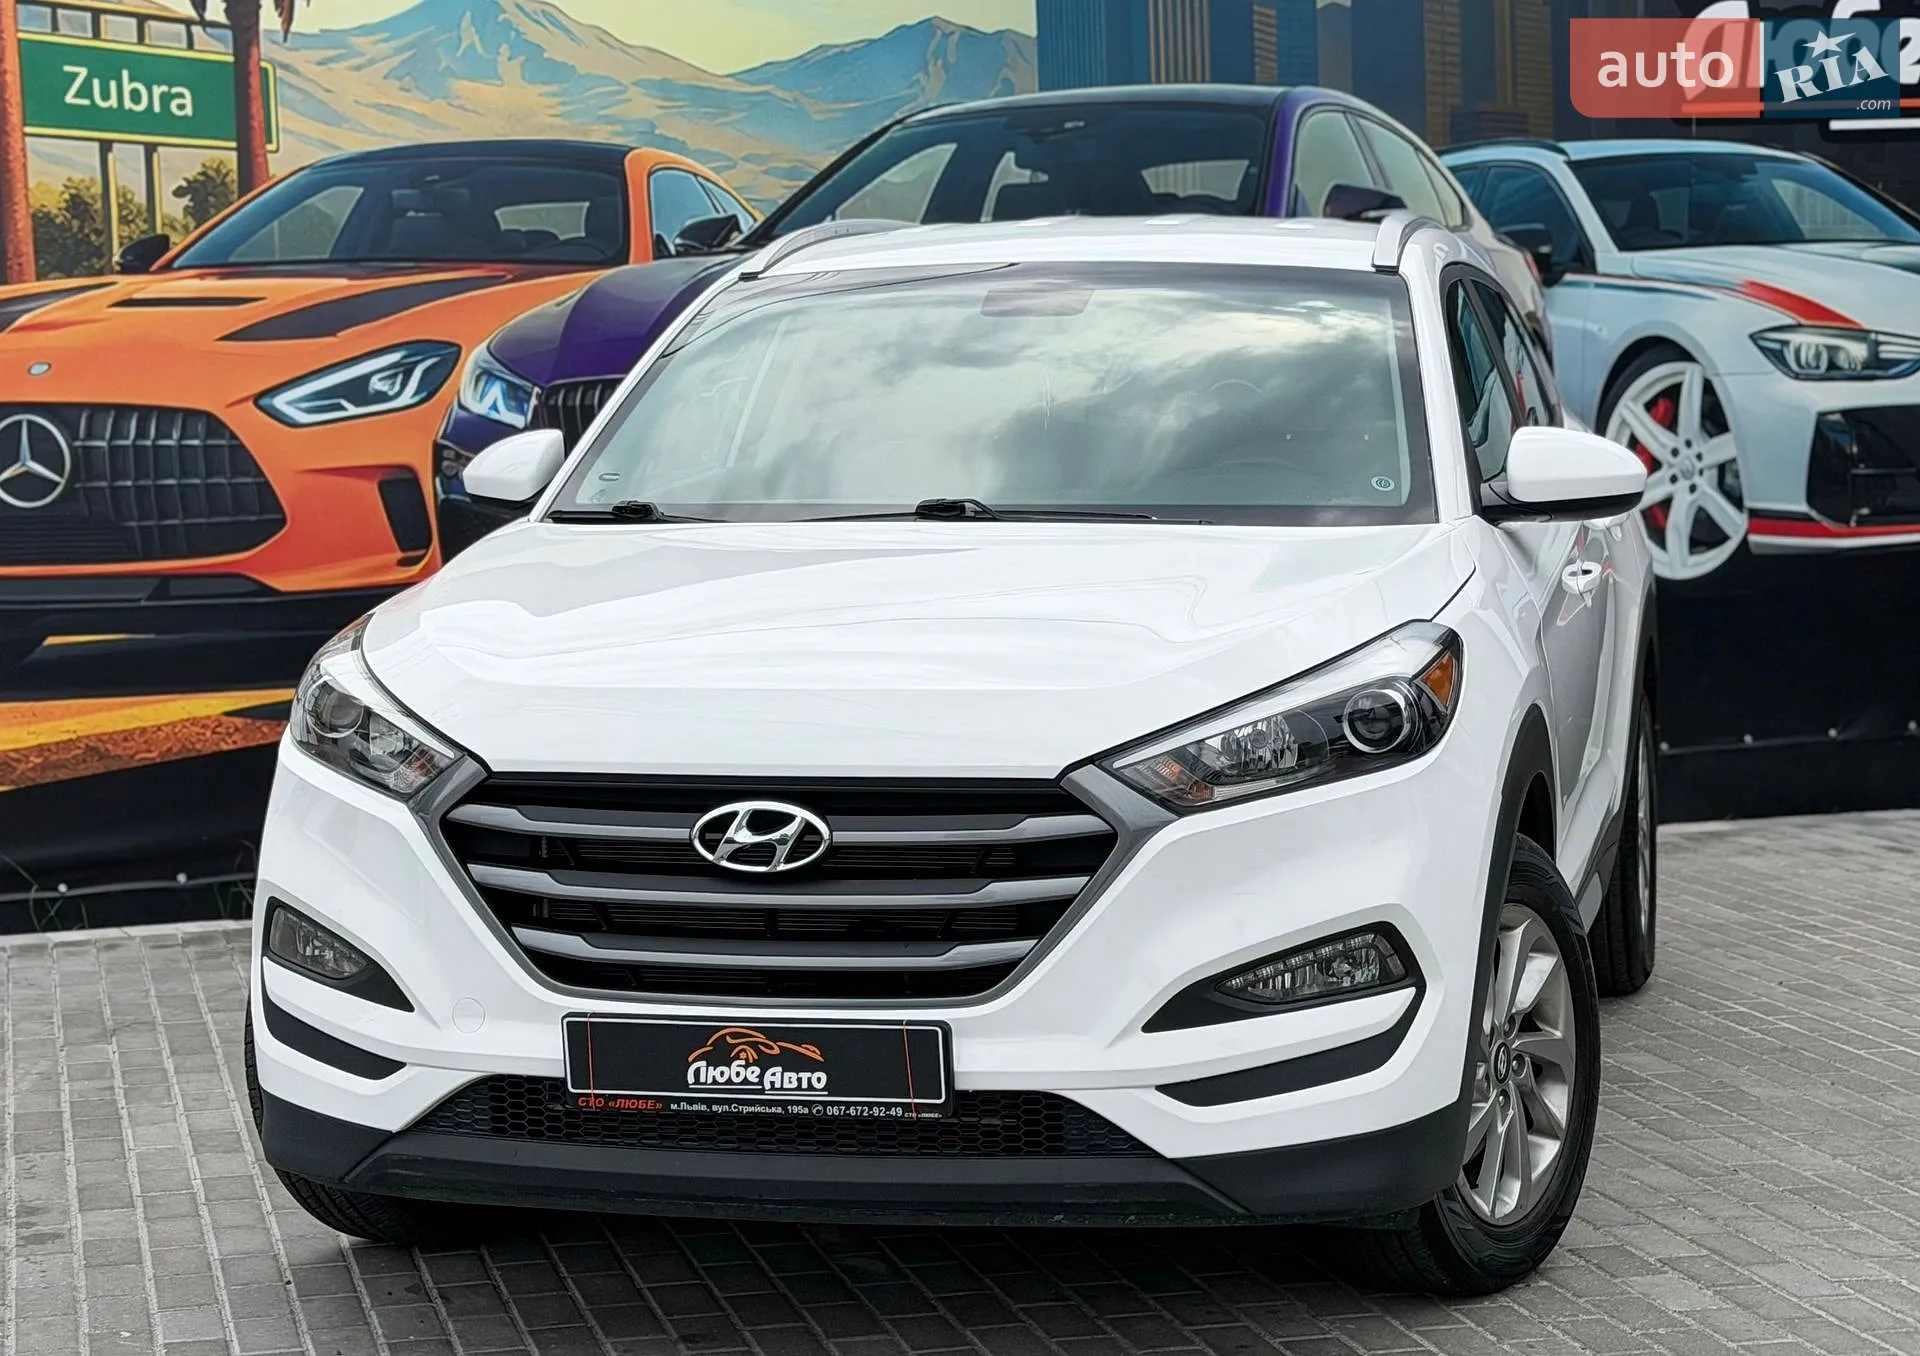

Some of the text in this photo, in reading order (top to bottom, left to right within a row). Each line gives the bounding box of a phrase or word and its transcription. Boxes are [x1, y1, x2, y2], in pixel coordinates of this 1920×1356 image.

[62, 64, 194, 117] Zubra
[686, 1060, 761, 1085] Любе
[578, 1096, 605, 1107] СТО
[826, 1105, 903, 1117] 067-672-92-49
